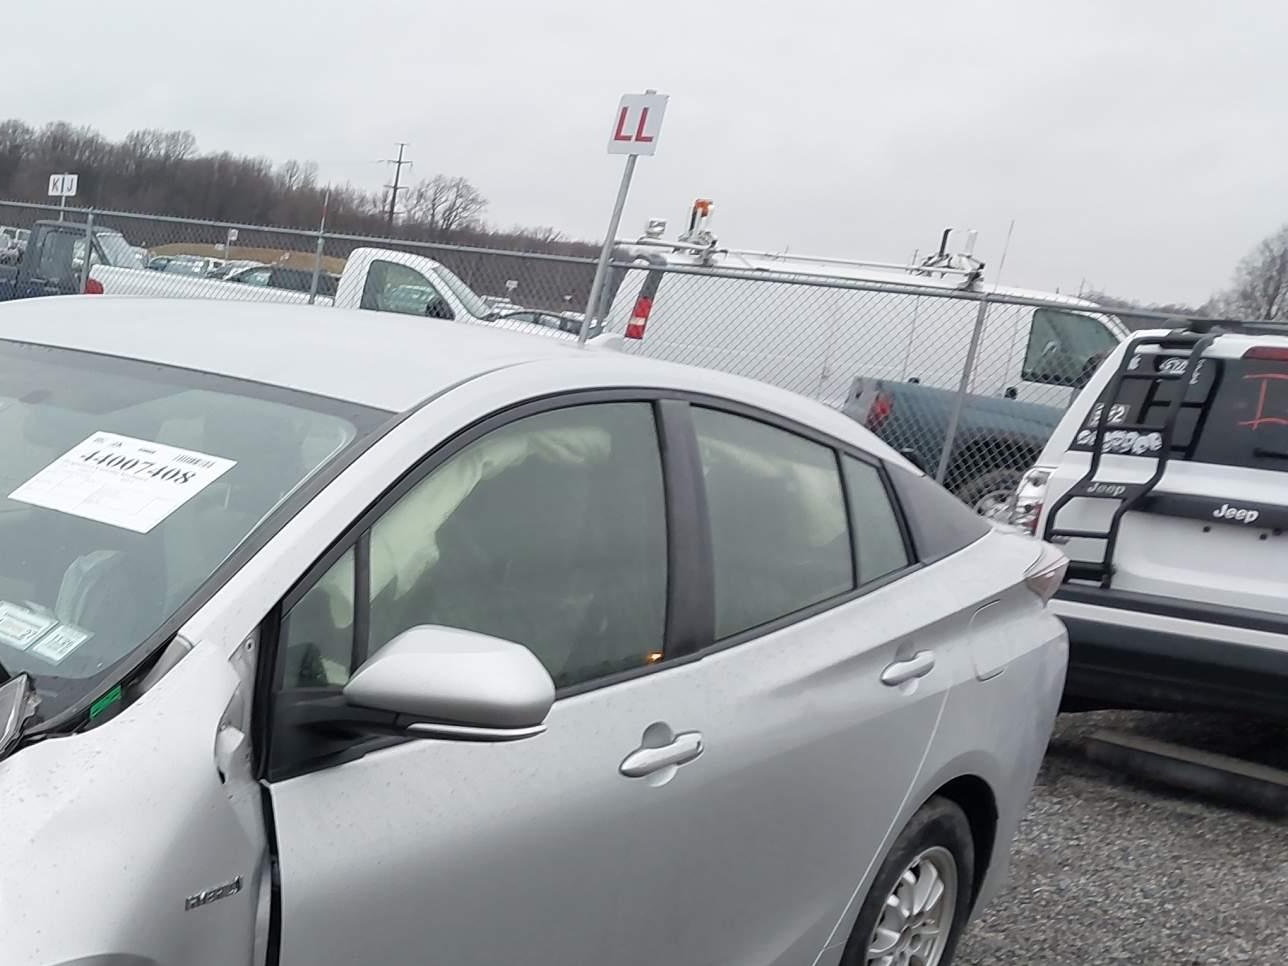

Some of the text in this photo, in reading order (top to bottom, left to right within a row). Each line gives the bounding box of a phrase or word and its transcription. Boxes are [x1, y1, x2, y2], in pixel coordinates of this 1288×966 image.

[614, 106, 654, 142] LL
[52, 177, 61, 192] K
[81, 449, 196, 485] 44007408
[1087, 481, 1127, 497] Jeep
[1213, 503, 1260, 524] Jeep
